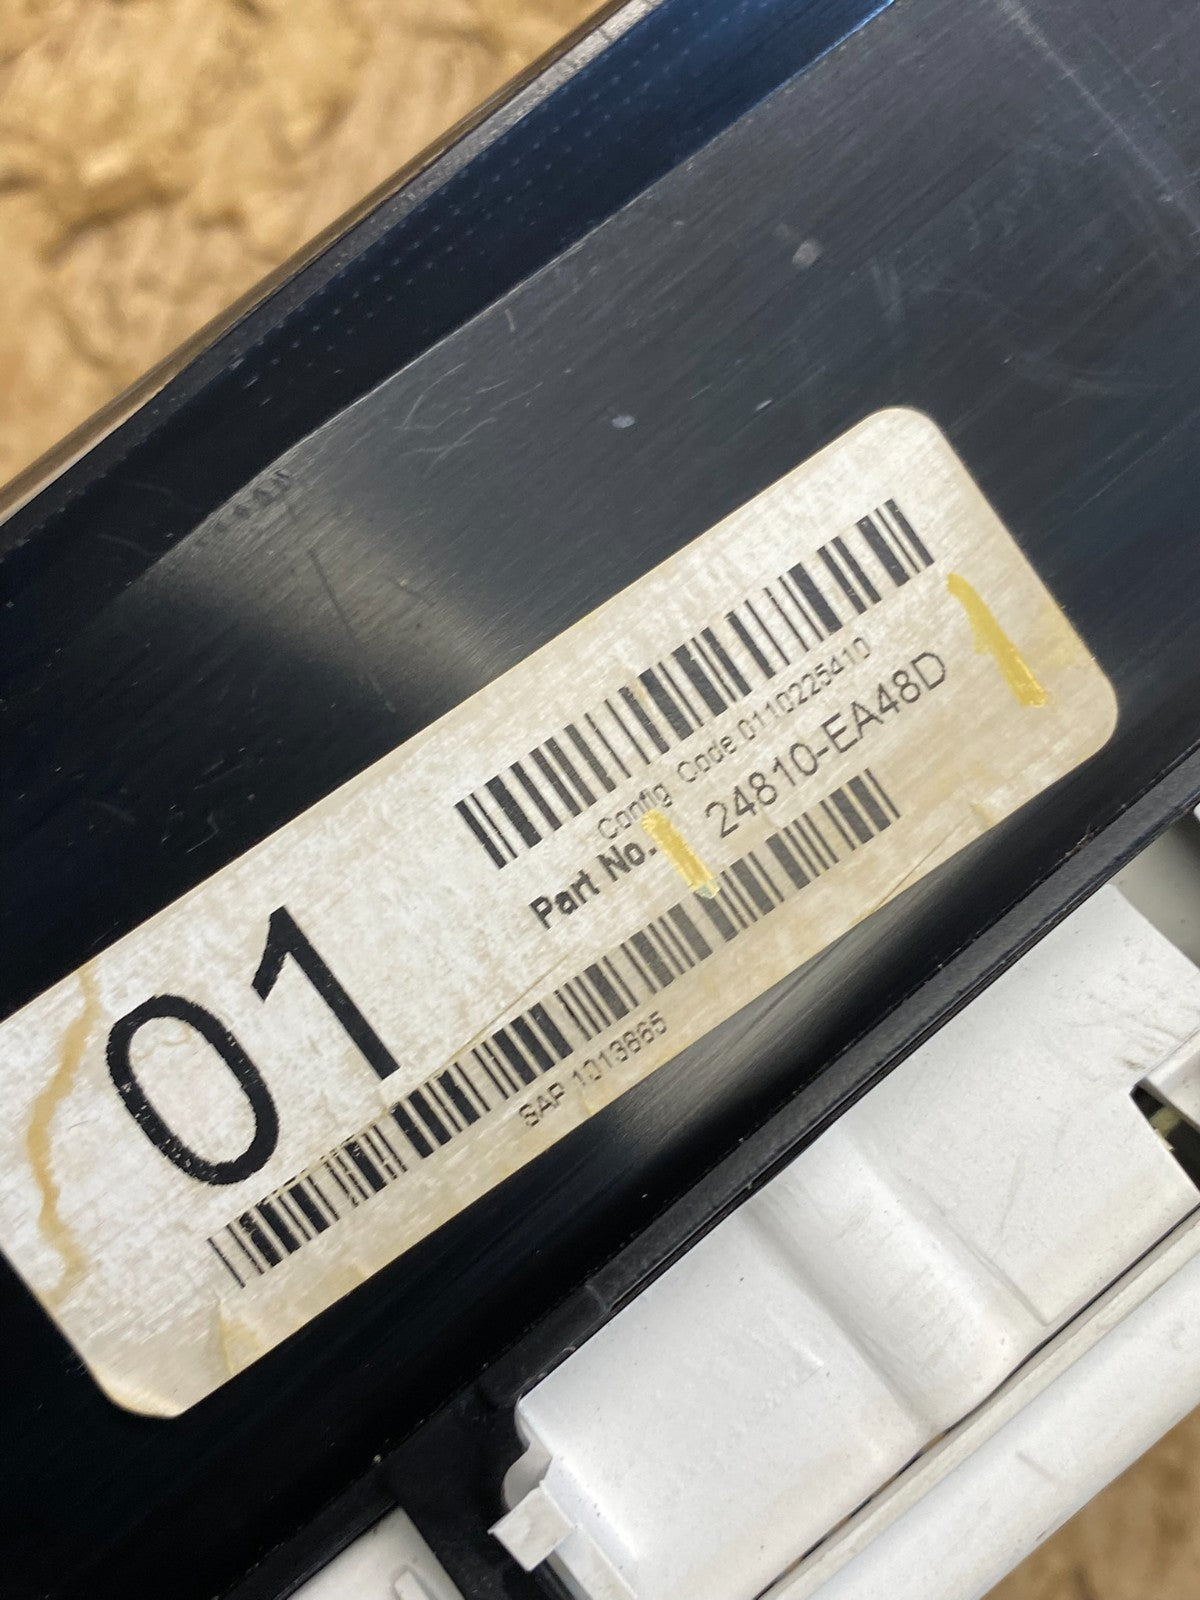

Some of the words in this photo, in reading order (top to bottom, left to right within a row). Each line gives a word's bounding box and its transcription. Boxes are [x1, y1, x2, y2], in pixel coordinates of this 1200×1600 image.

[529, 870, 600, 930] Part
[596, 843, 657, 882] No.
[705, 652, 947, 839] 24810-EA48D
[598, 784, 672, 839] Config
[677, 735, 736, 784] Code
[737, 636, 871, 740] 0110225410
[105, 905, 400, 1185] 01
[519, 1082, 565, 1127] SAP
